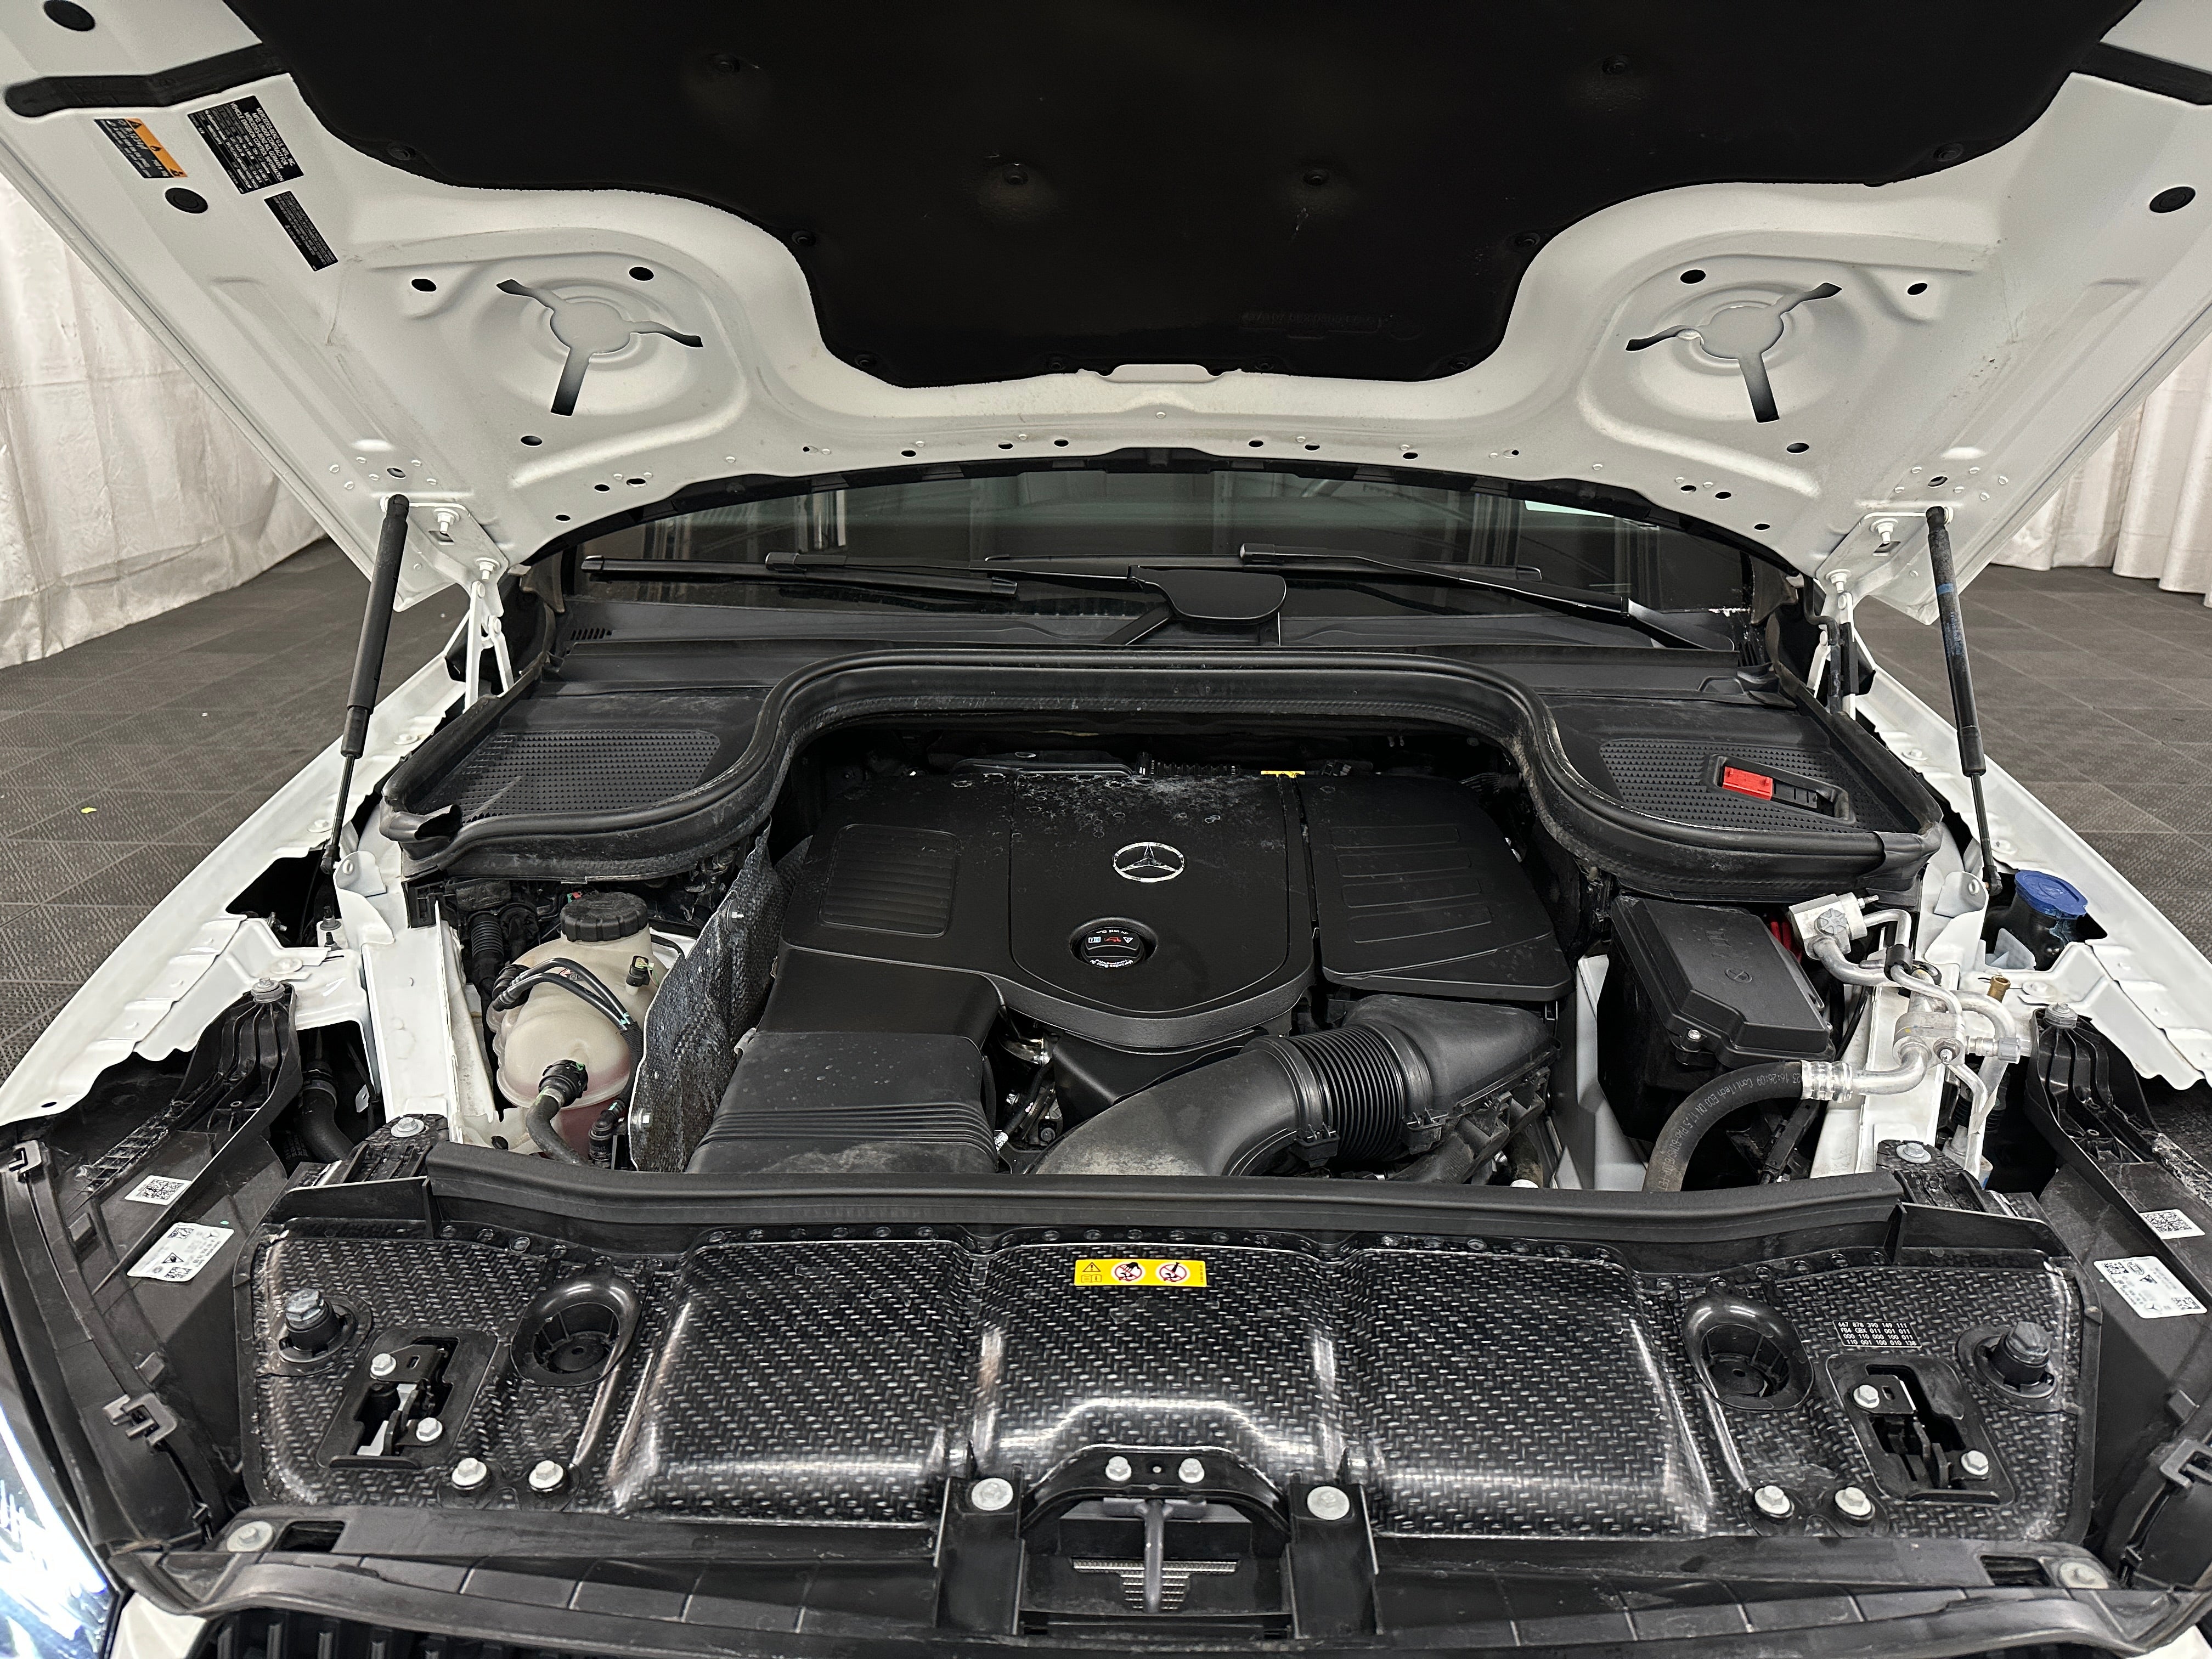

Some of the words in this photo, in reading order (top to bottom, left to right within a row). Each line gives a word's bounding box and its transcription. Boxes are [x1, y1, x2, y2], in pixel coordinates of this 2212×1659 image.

[229, 102, 244, 119] VEHICLE
[240, 119, 257, 138] EMISSION
[252, 138, 268, 156] CONTROL
[264, 156, 284, 181] INFORMATION
[243, 112, 267, 144] MERCEDES-BENZ
[268, 150, 284, 169] GERMANY
[255, 107, 279, 139] MERCEDES-BENZ
[287, 157, 295, 166] INC.
[257, 123, 270, 137] UNDER
[266, 137, 283, 156] CONTRACT
[279, 157, 288, 165] FOR
[1717, 1077, 1753, 1102] ContiTech
